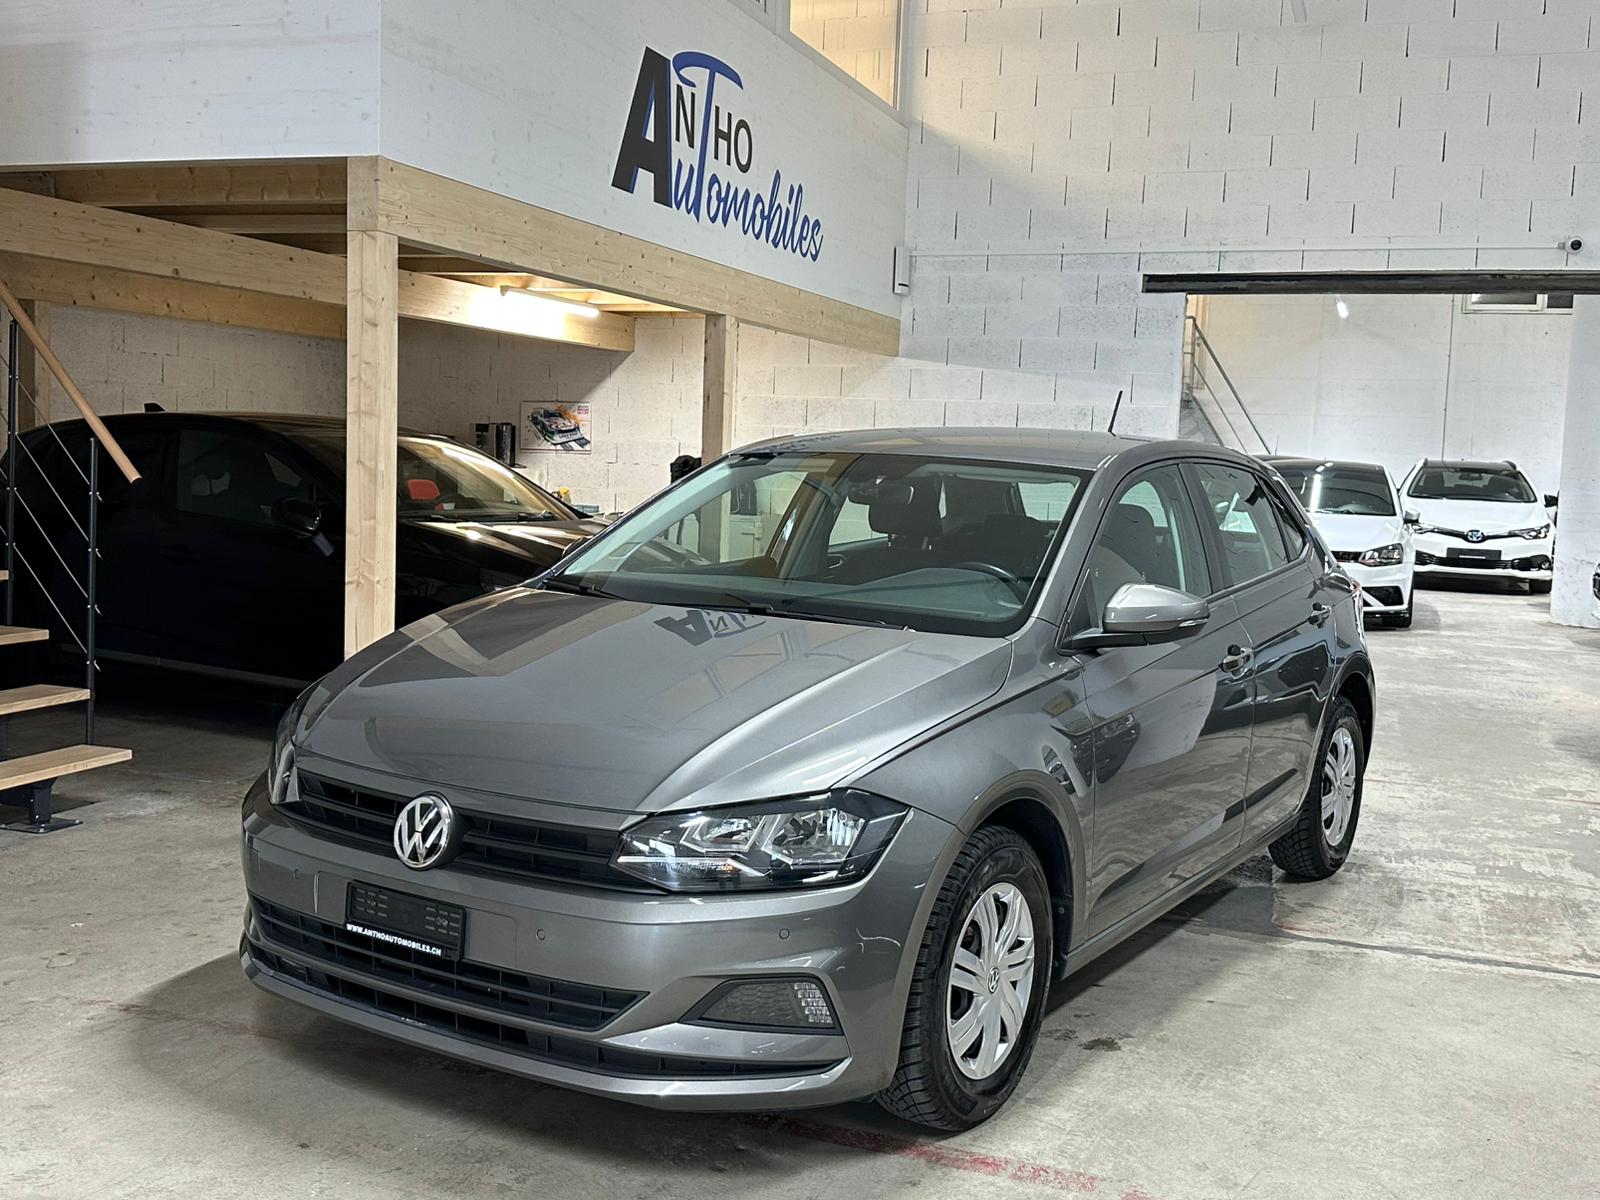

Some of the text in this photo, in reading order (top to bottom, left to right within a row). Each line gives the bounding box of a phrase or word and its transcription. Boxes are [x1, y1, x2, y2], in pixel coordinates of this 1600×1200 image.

[611, 46, 753, 223] ANTHO
[394, 796, 450, 868] VW
[346, 923, 442, 956] WWW.ANTHOAUTOMOBILES.CH
